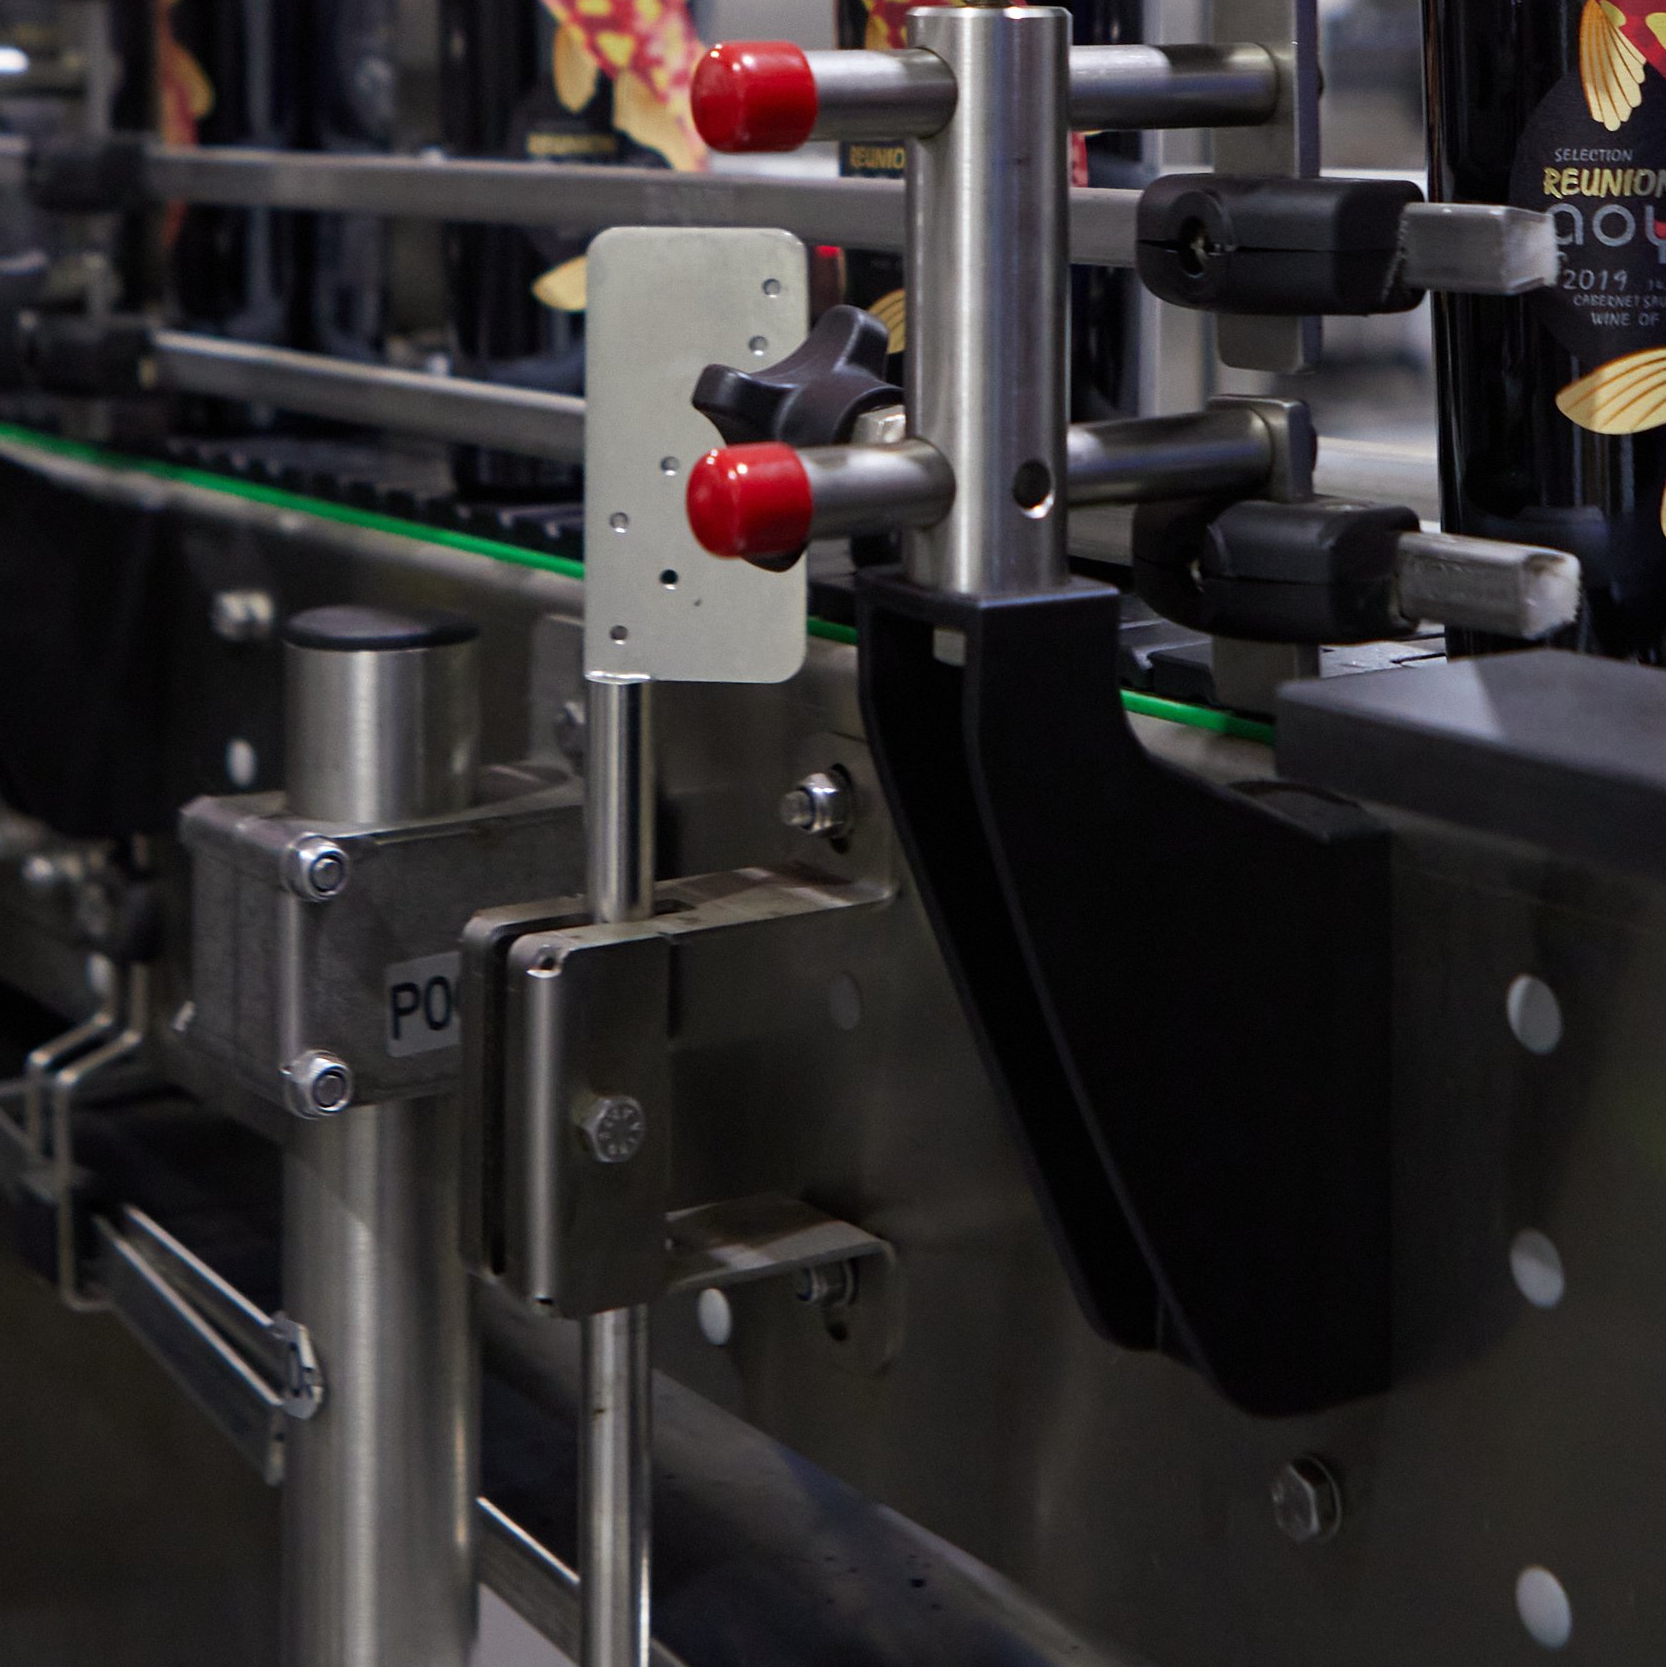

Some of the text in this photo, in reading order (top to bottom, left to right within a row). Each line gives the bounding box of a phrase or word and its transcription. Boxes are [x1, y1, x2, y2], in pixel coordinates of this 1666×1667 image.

[1554, 148, 1633, 162] SELECTION
[1563, 269, 1628, 291] 2019
[1573, 294, 1641, 307] CABERNET
[1590, 312, 1630, 326] WINE
[1638, 312, 1659, 326] OF
